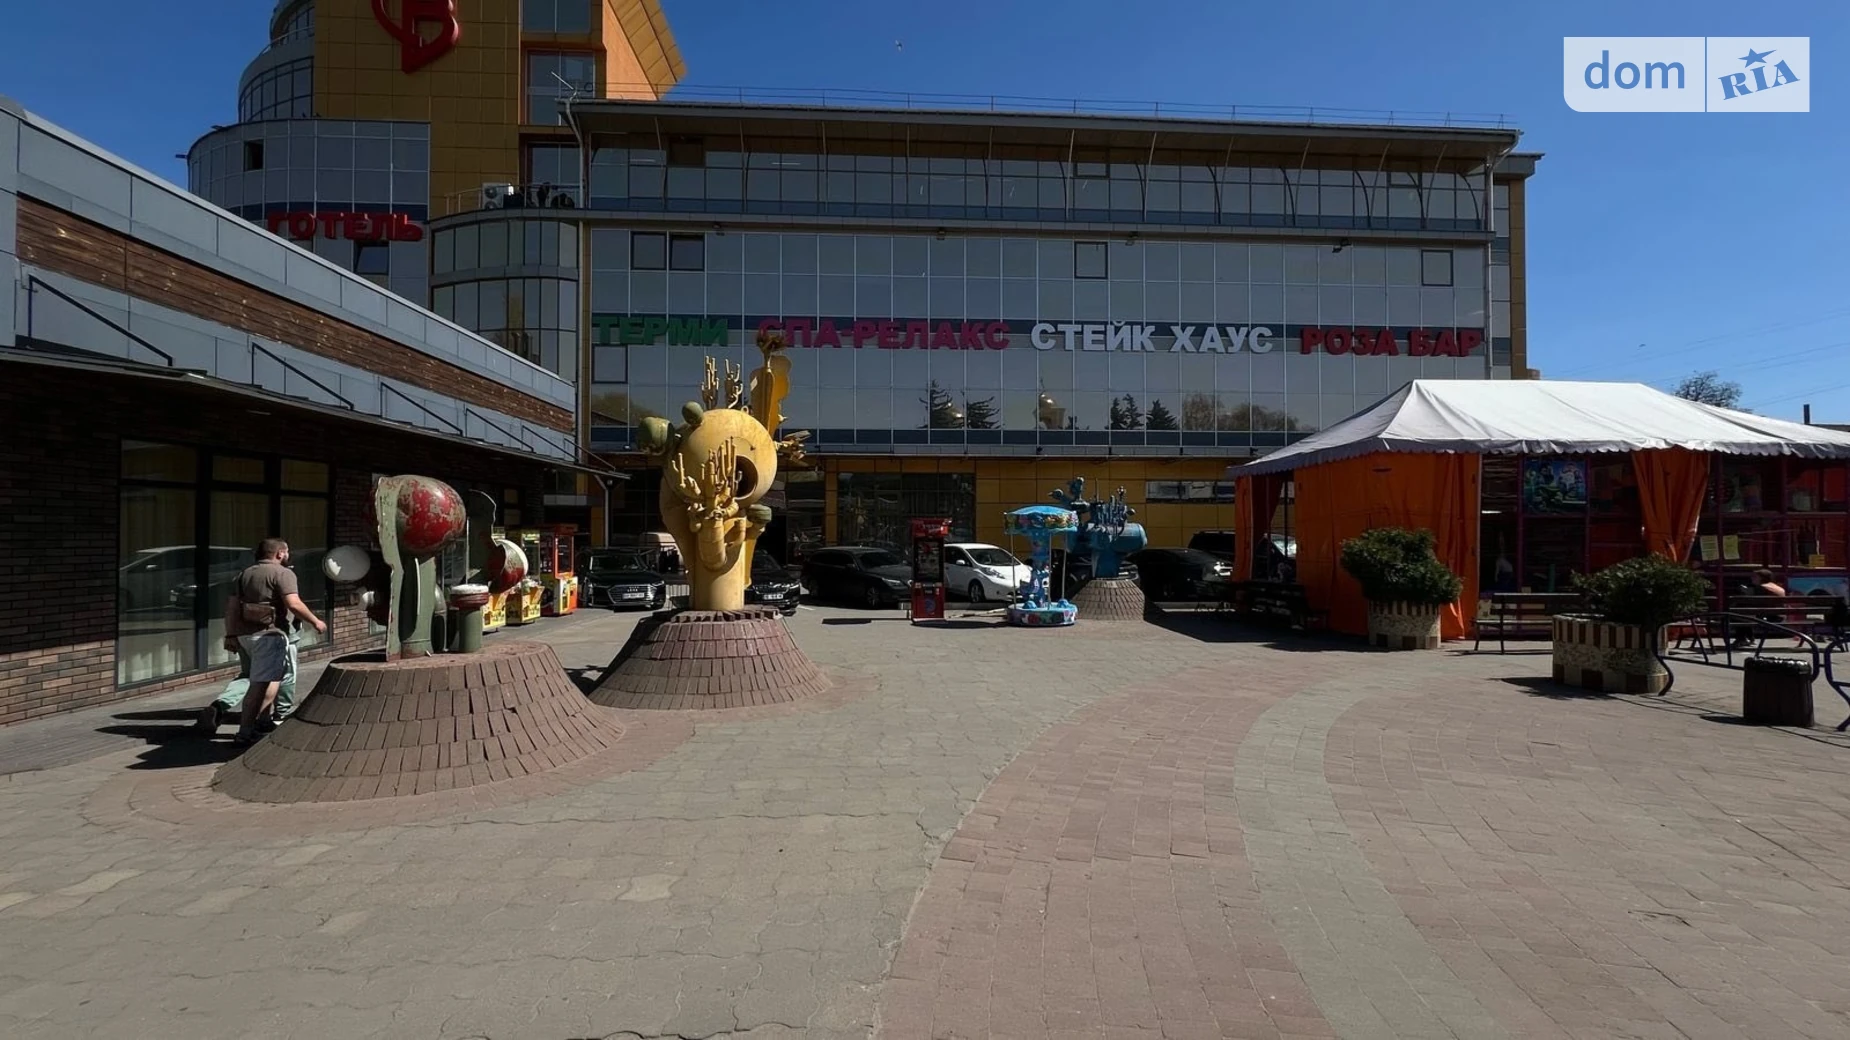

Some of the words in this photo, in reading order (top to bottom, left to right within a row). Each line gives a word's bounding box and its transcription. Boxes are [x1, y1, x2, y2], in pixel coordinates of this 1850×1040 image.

[267, 212, 423, 242] ГОТЕЛЬ
[592, 316, 728, 347] ТЕРМИ
[1031, 320, 1156, 352] СТЕЙК
[1169, 325, 1273, 354] ХАУС
[1300, 327, 1399, 356] РОЗА
[1408, 330, 1481, 357] БАР
